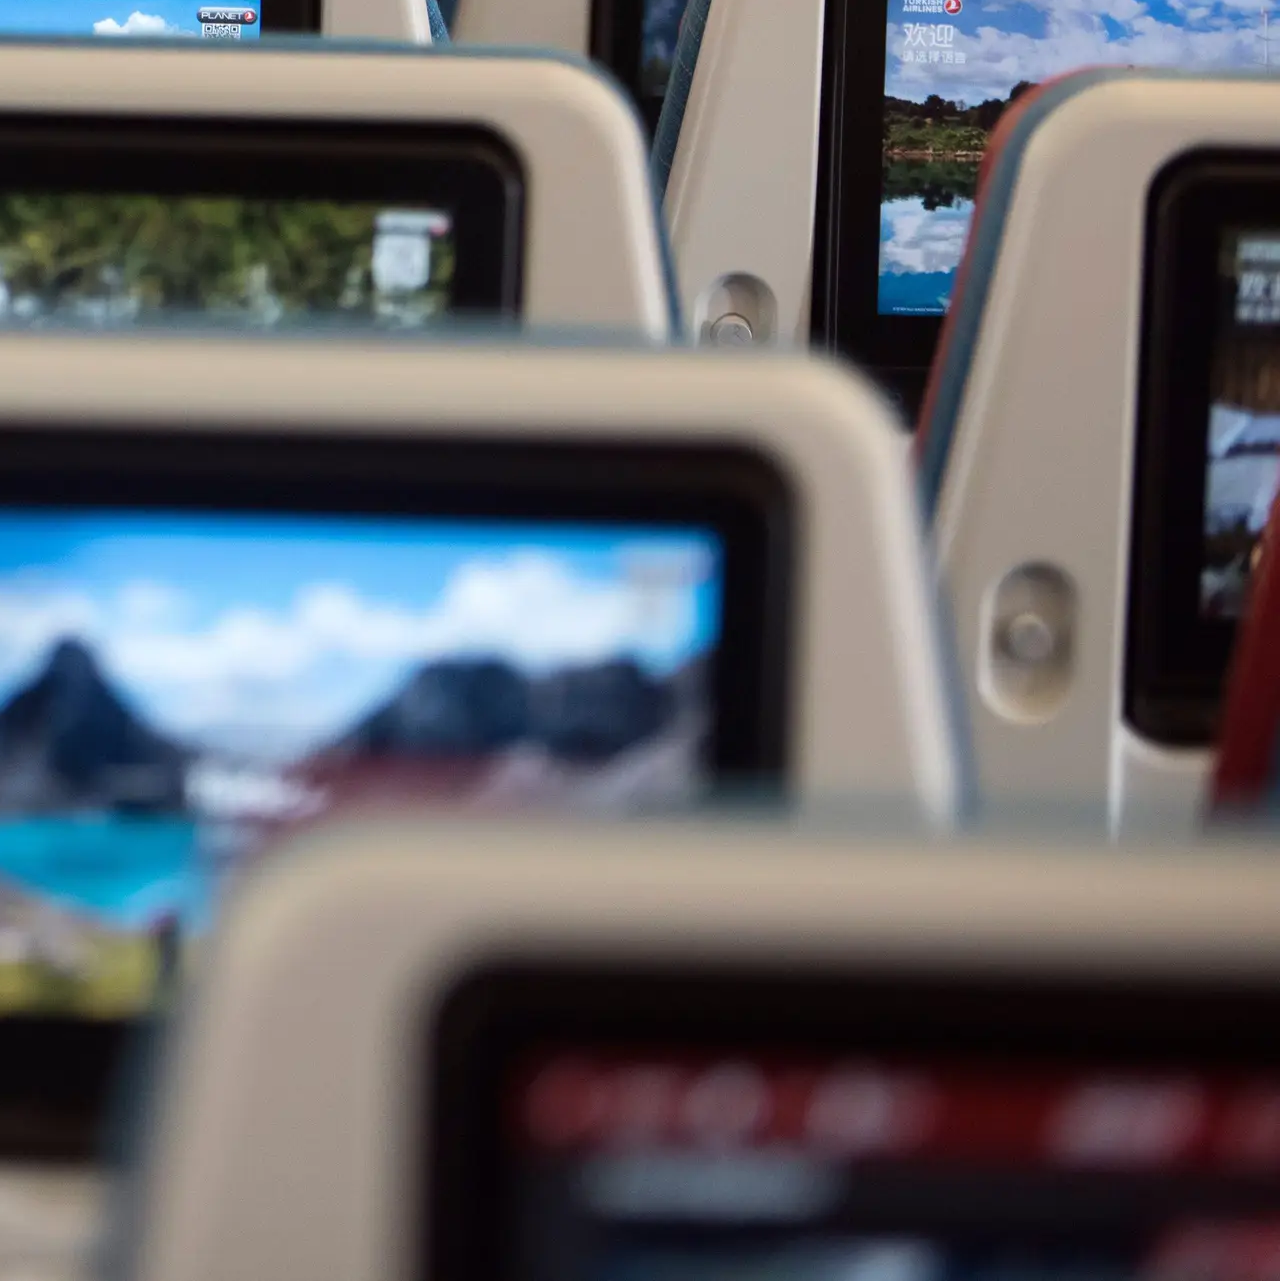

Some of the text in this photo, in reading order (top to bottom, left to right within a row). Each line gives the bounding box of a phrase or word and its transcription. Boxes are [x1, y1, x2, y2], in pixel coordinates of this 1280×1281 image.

[902, 5, 943, 13] AIRLINES
[201, 11, 242, 20] PLANET
[903, 22, 954, 47] 欢迎
